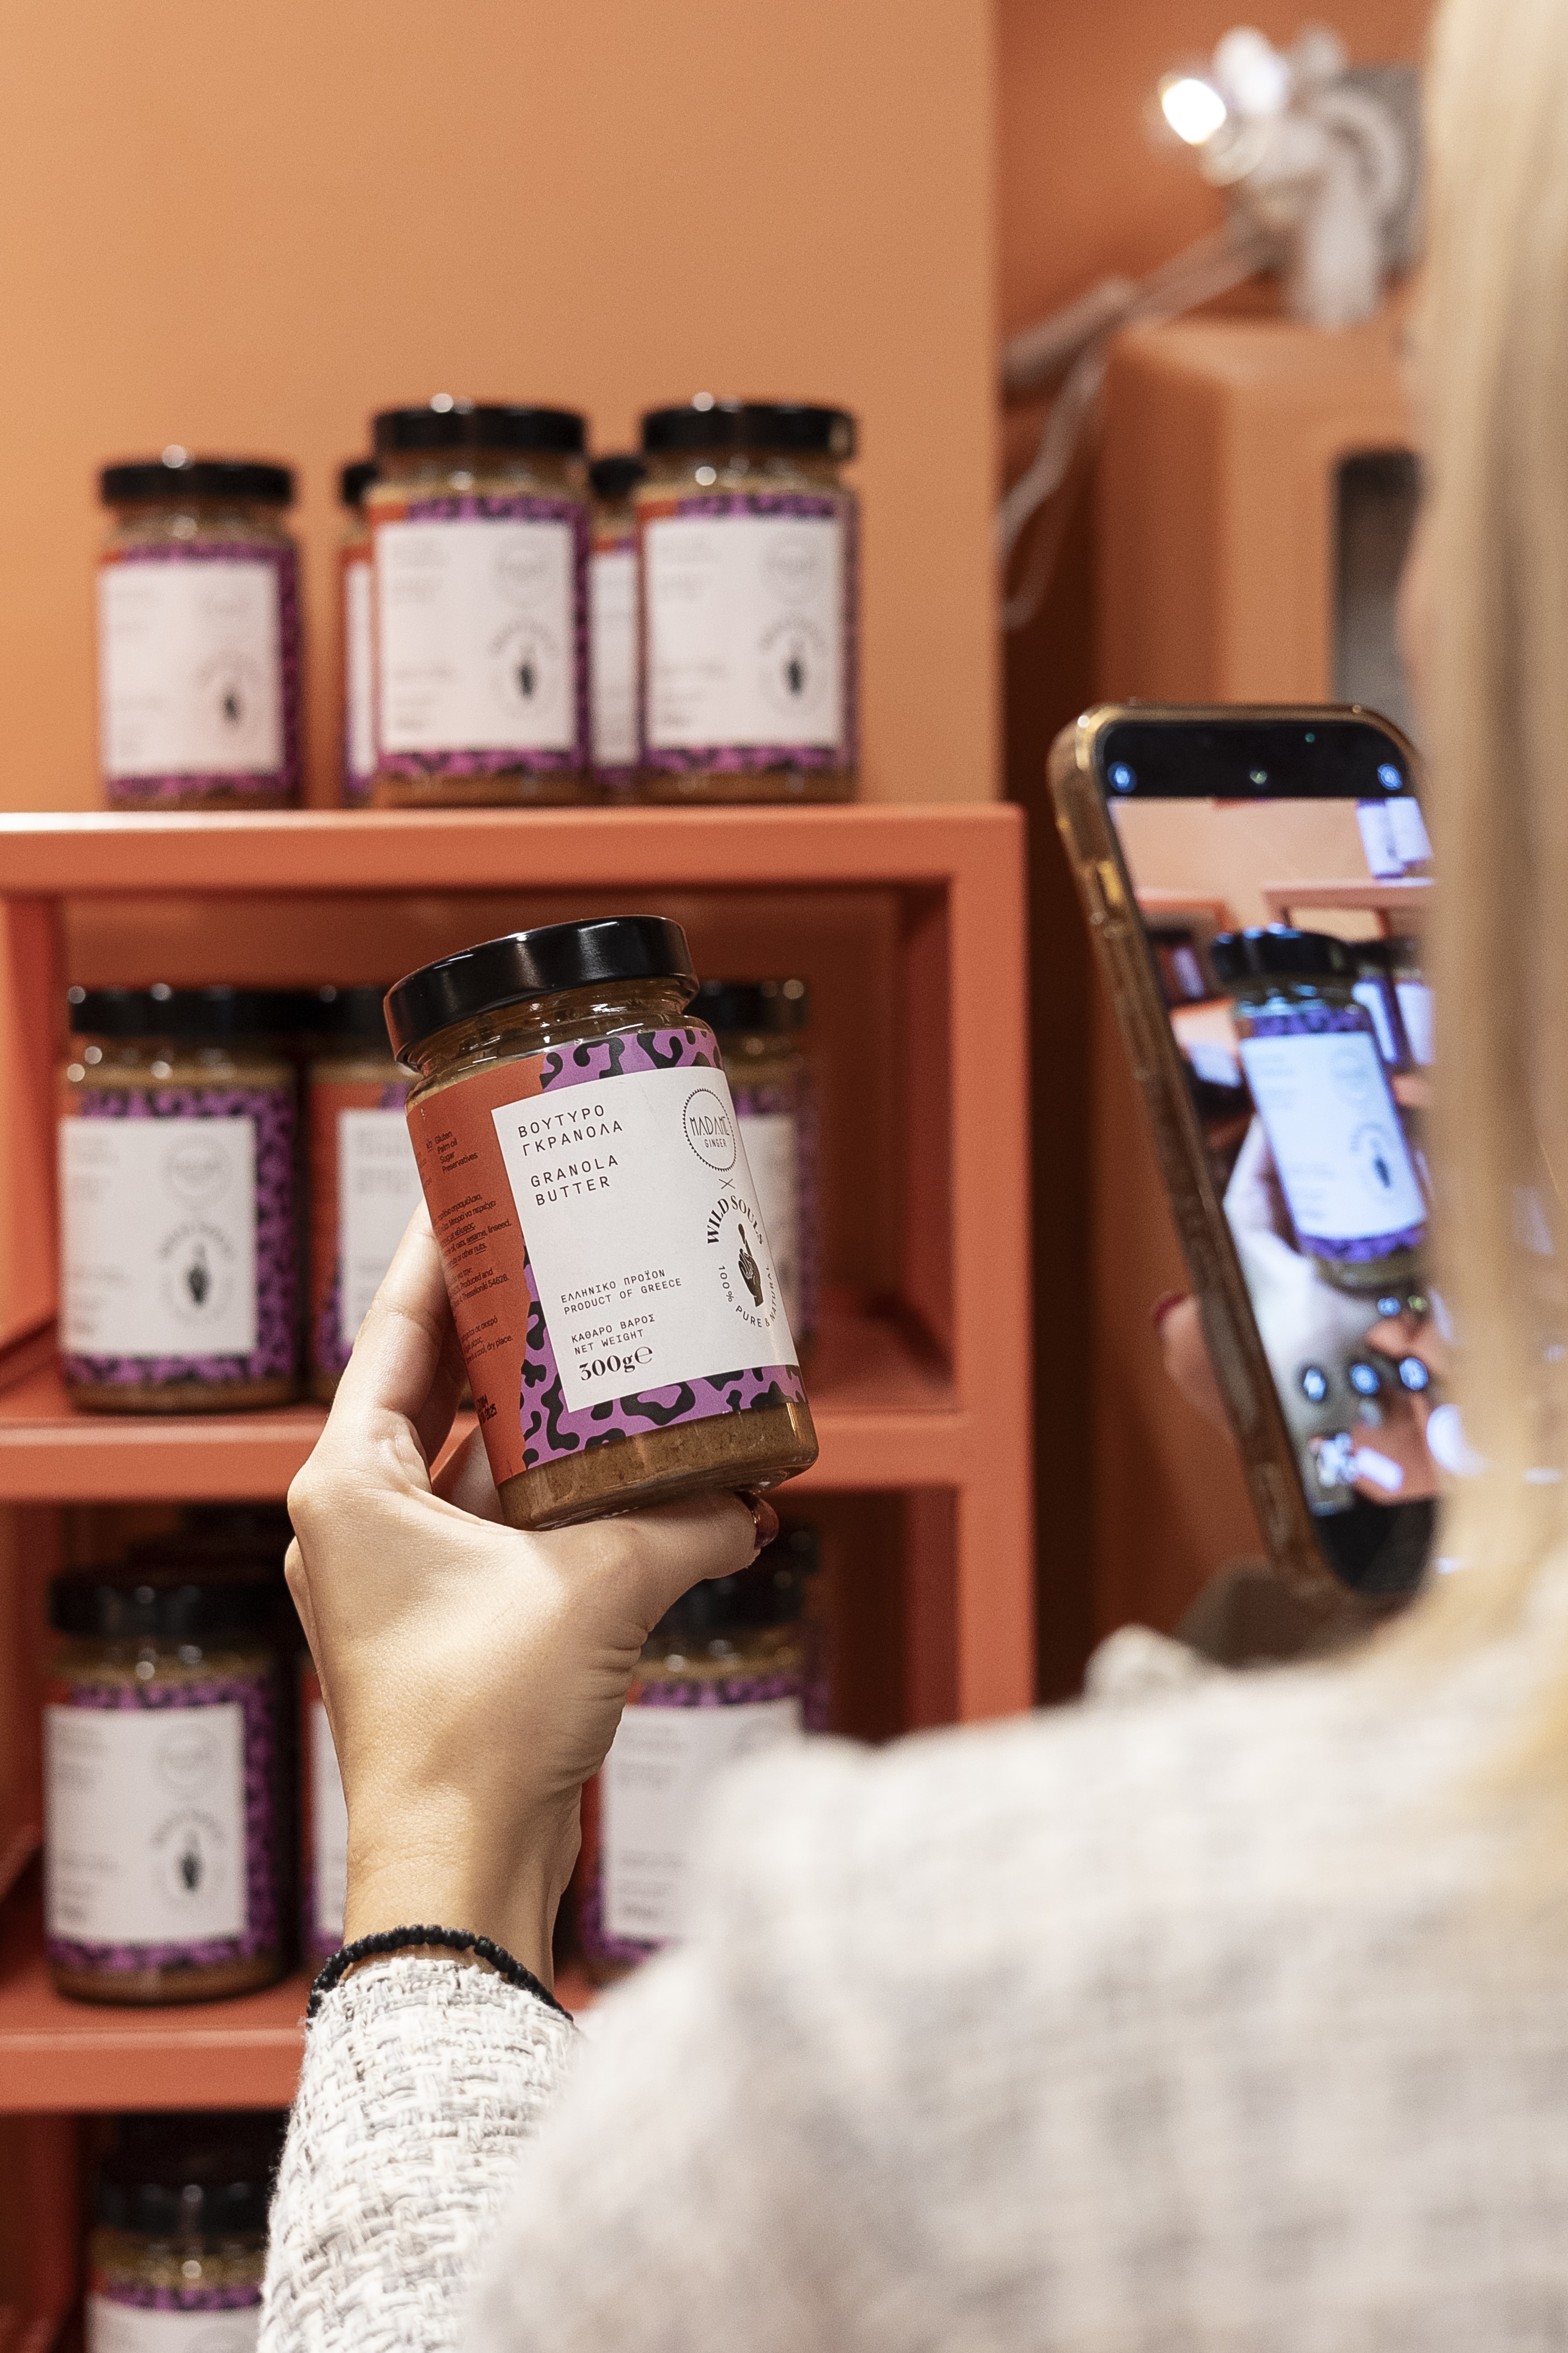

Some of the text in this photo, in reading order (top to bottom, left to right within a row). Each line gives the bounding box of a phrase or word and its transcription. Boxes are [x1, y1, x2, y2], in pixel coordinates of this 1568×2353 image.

[518, 1105, 604, 1138] ΒΟΥΤΥΡΟ
[689, 1116, 730, 1136] MADAME
[435, 1131, 452, 1144] Gluten
[437, 1143, 450, 1154] Palm
[522, 1120, 622, 1156] ΓΚΡΑΝΟΛΑ
[704, 1139, 727, 1147] GINGER
[440, 1151, 455, 1164] Sugar
[442, 1152, 478, 1172] Preservatives
[531, 1155, 618, 1187] GRANOLA
[536, 1176, 610, 1206] BUTTER
[707, 1195, 763, 1244] WILD SOULS
[482, 1267, 493, 1278] and
[488, 1273, 509, 1287] 54628.
[561, 1269, 665, 1303] ΕΛΛΗΝΙΚΟ ΠΡΟΪΟΝ
[564, 1278, 682, 1314] PRODUCT OF GREECE
[719, 1265, 734, 1302] 100%
[736, 1305, 762, 1328] PURE
[496, 1334, 514, 1349] place.
[572, 1314, 655, 1343] ΚΑΘΑΡΟ ΒΑΡΟΣ
[574, 1329, 643, 1355] NET WEIGHT
